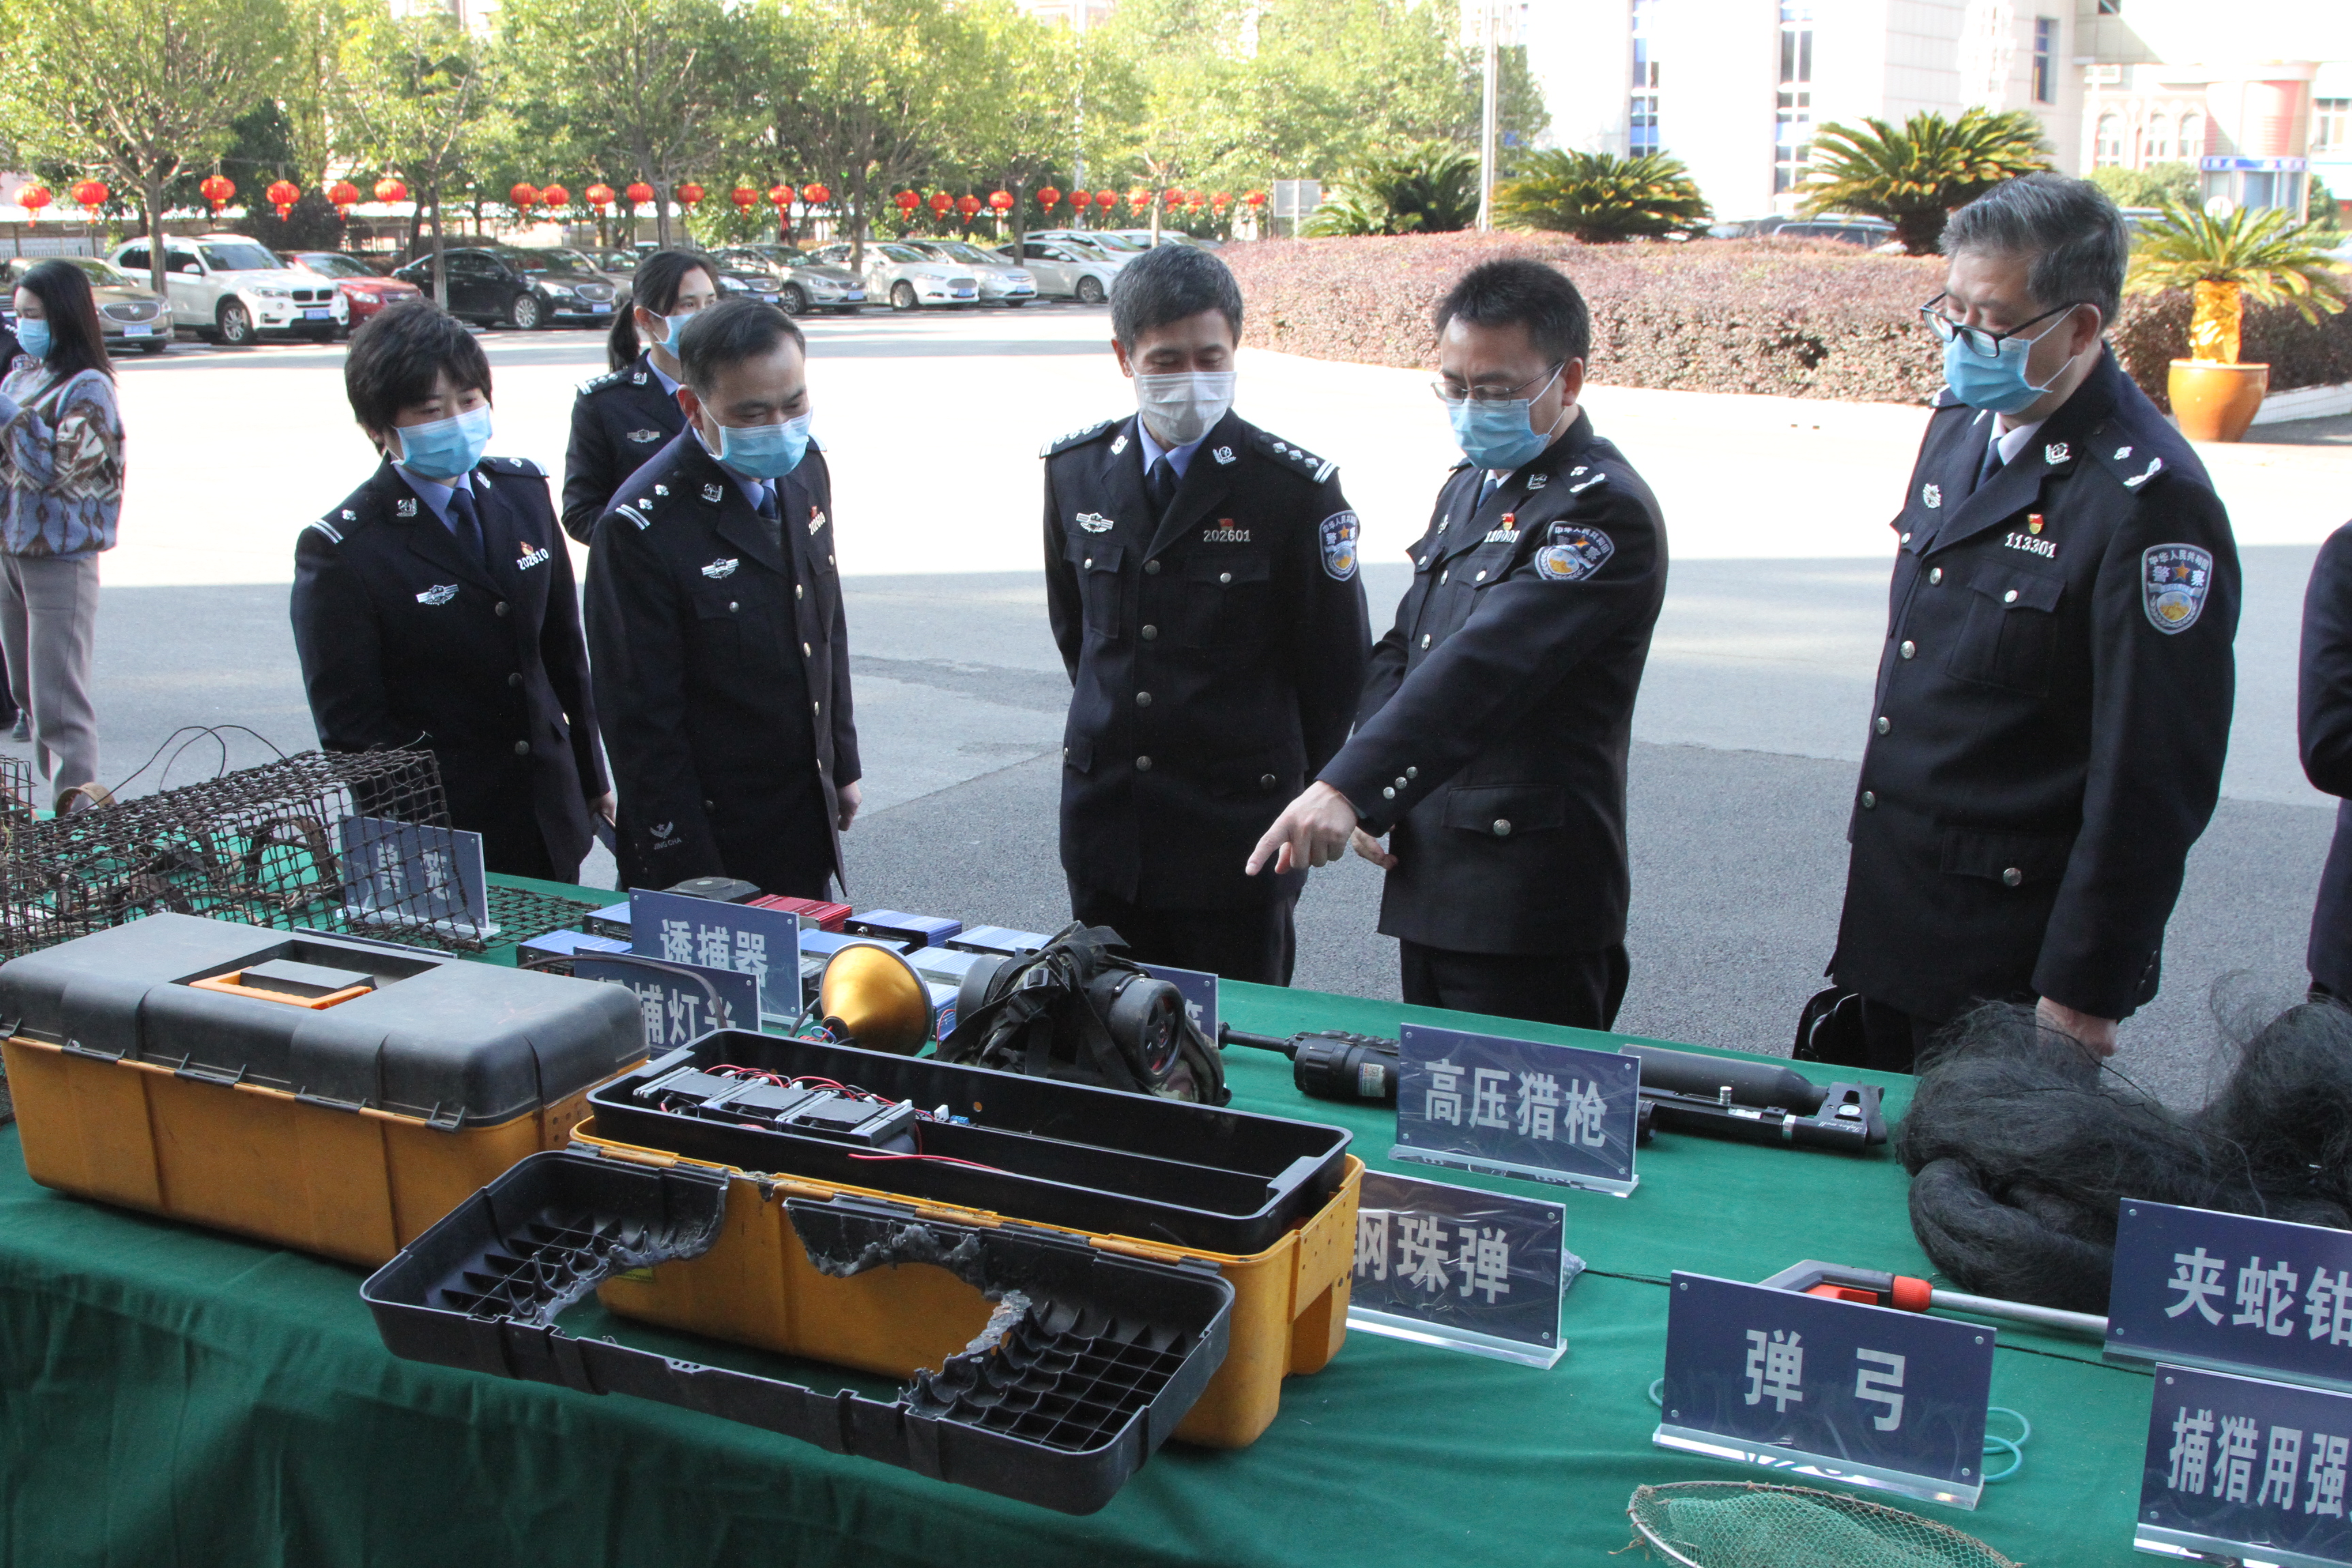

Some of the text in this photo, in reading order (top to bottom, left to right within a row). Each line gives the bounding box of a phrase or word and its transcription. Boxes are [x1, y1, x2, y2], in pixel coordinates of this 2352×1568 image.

[517, 548, 549, 570] 202610
[1203, 529, 1251, 542] 202601
[2004, 532, 2057, 558] 113301
[2148, 549, 2209, 570] 中华人民共和国
[668, 837, 682, 846] CHA
[659, 919, 768, 987] 诱捕器
[599, 977, 736, 1046] 捕灯光
[1425, 1058, 1607, 1147] 高压猎枪
[2164, 1247, 2352, 1348] 夹蛇钳
[1744, 1329, 1906, 1431] 弹弓
[2168, 1406, 2352, 1519] 捕猎用强
